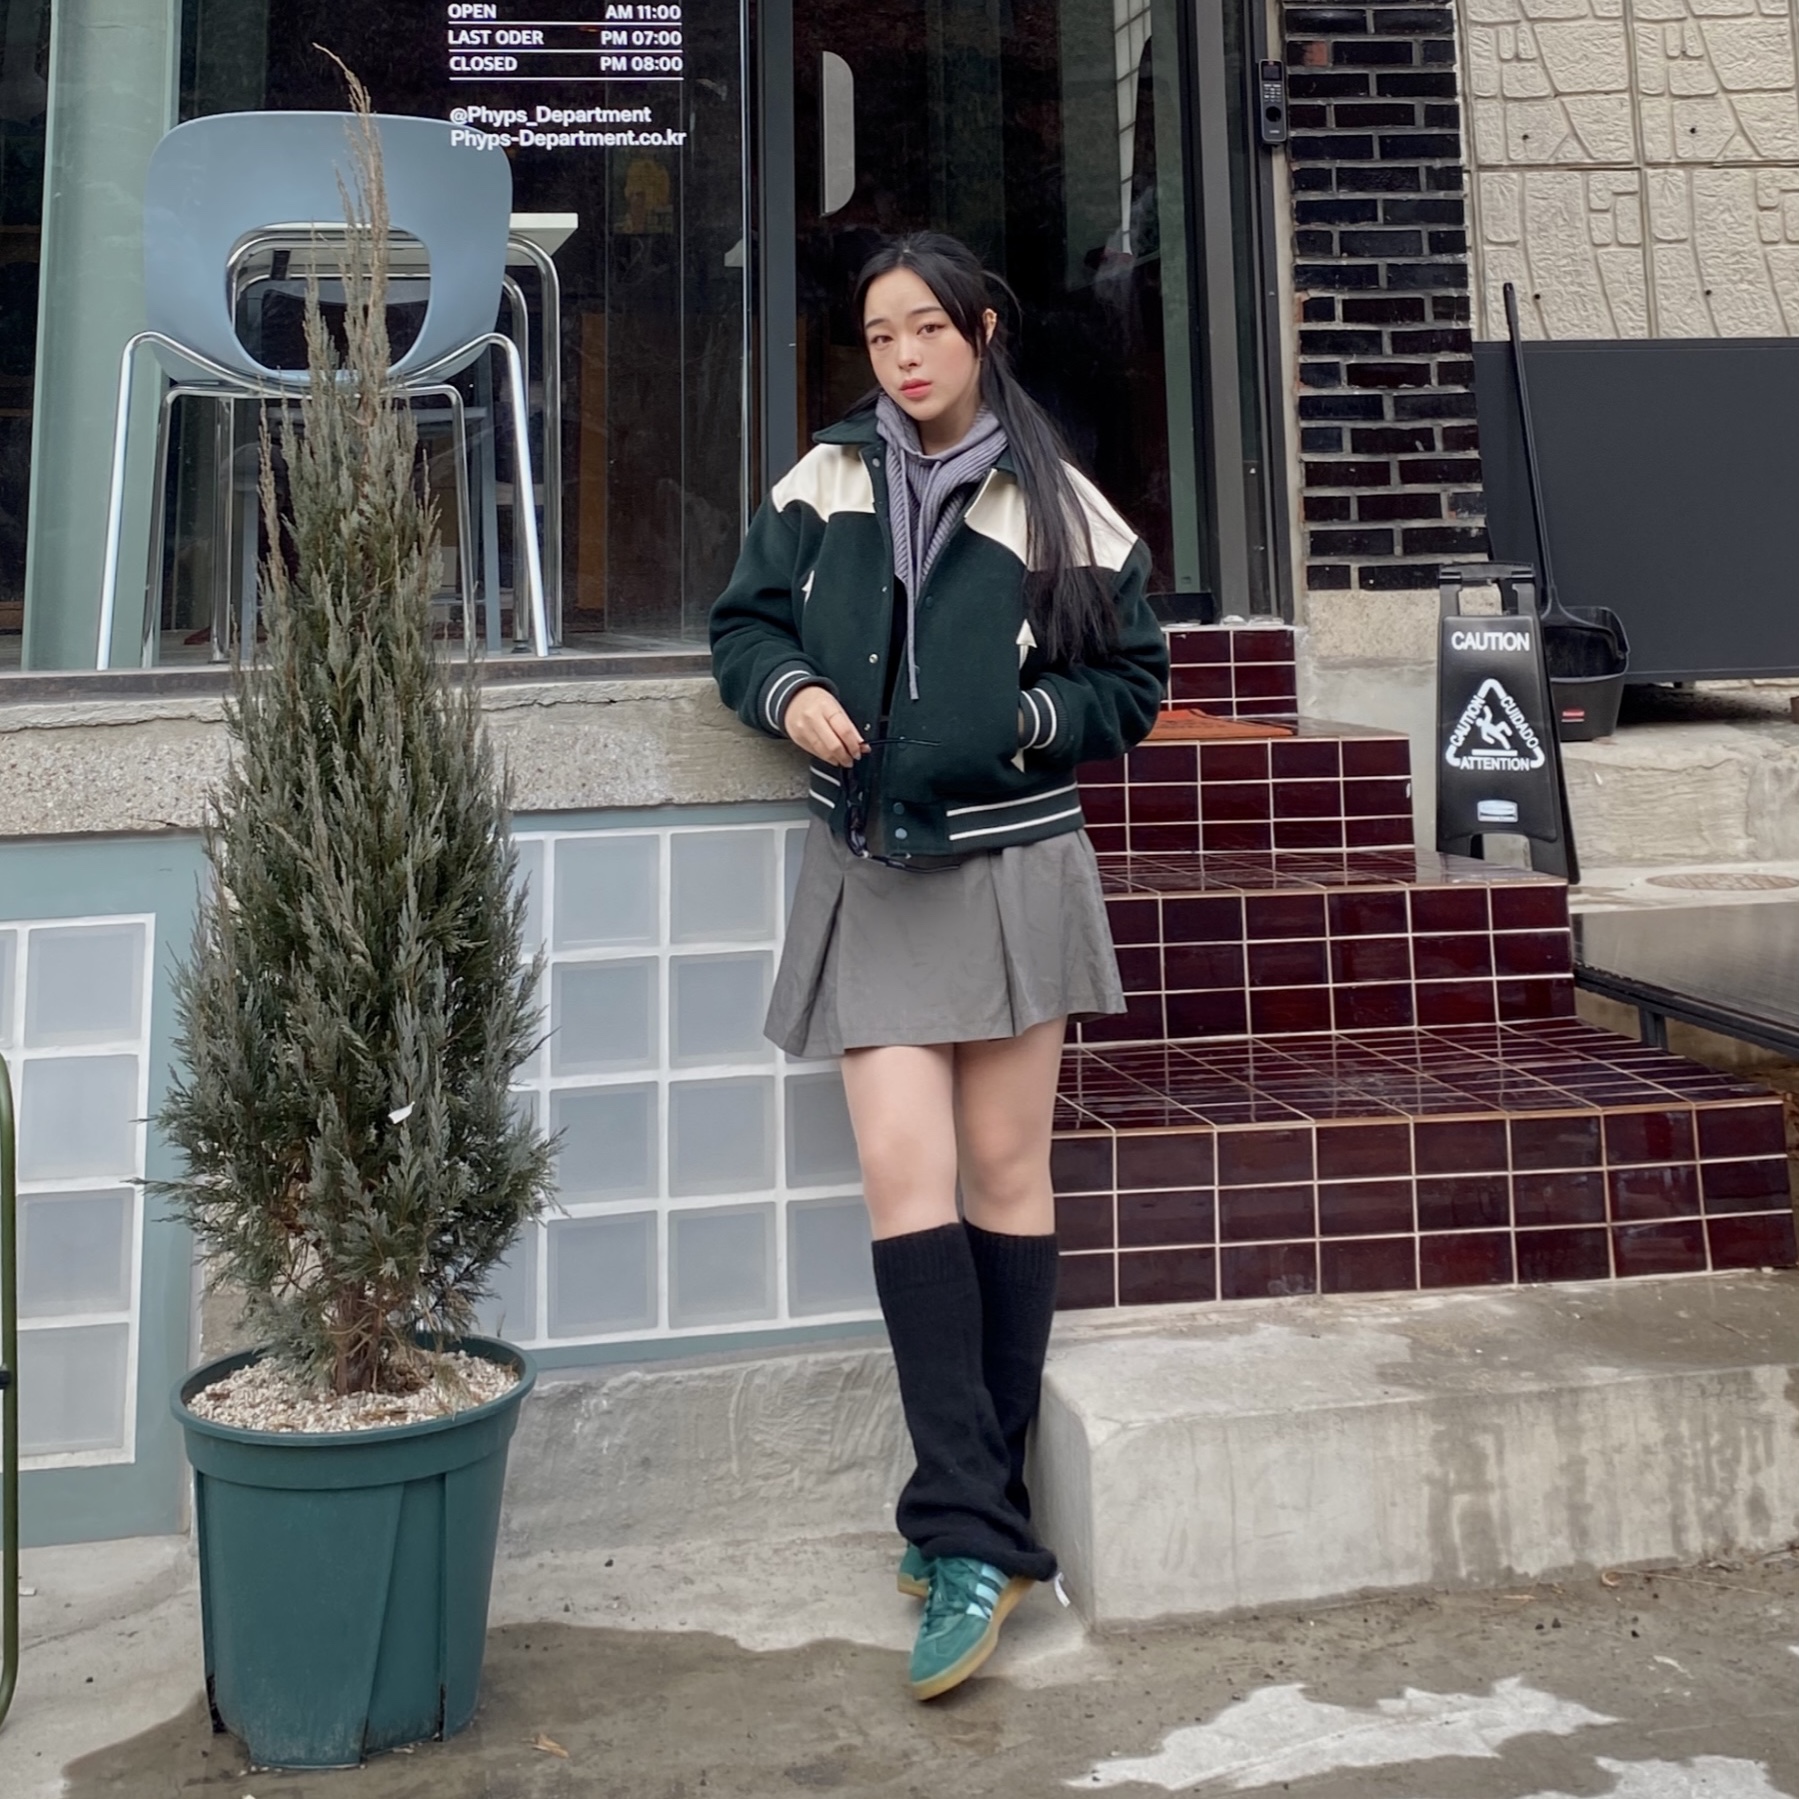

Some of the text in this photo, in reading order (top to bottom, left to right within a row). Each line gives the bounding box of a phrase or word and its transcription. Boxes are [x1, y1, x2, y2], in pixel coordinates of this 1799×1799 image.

[447, 4, 682, 20] OPEN AM 11:00
[448, 30, 682, 46] LAST ODER PM 07:00
[449, 57, 683, 71] CLOSED PM 08:00
[450, 106, 652, 126] @Phyps_Department
[451, 129, 687, 149] Phyps-Department.co.kr
[1451, 631, 1530, 650] CAUTION
[1450, 695, 1486, 747] CAUTION
[1500, 696, 1539, 749] CUIDADO
[1460, 757, 1530, 771] ATTENTION
